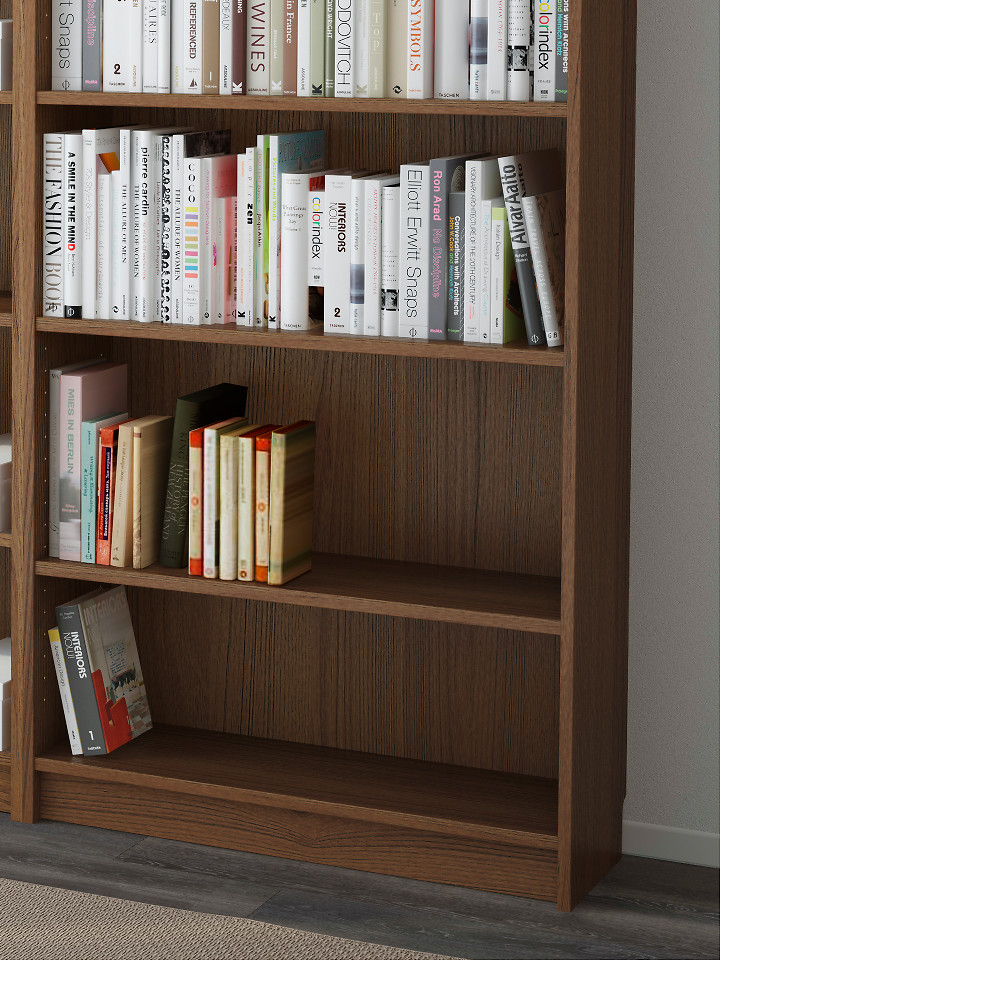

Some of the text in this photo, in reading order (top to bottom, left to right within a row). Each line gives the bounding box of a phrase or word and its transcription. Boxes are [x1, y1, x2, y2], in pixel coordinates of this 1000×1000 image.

[286, 0, 295, 10] in
[286, 11, 295, 45] France
[56, 11, 75, 70] Snaps
[189, 1, 198, 60] REFERENCED
[250, 1, 266, 74] WINES
[113, 63, 122, 76] 2
[67, 151, 77, 160] A
[67, 160, 77, 191] SMILE
[67, 192, 77, 204] IN
[140, 146, 150, 217] pierre cardin
[44, 136, 63, 314] THE FASHION BOOK
[67, 204, 77, 224] THE
[67, 225, 77, 252] MIND
[174, 188, 182, 281] THE ALLURE OF WOMEN
[311, 196, 325, 260] colorindex
[328, 201, 338, 231] NOW!
[337, 201, 347, 253] INTERIORS
[403, 168, 423, 319] Elliott Erwitt Snaps
[453, 215, 461, 317] Conversations with Architects
[333, 307, 341, 319] 2
[67, 388, 75, 475] MIES IN BERLIN
[162, 463, 177, 541] NEW ZEALAND
[170, 463, 184, 525] HISTORY of
[62, 631, 75, 660] NOW!
[70, 631, 87, 680] INTERIORS
[88, 729, 95, 741] 1
